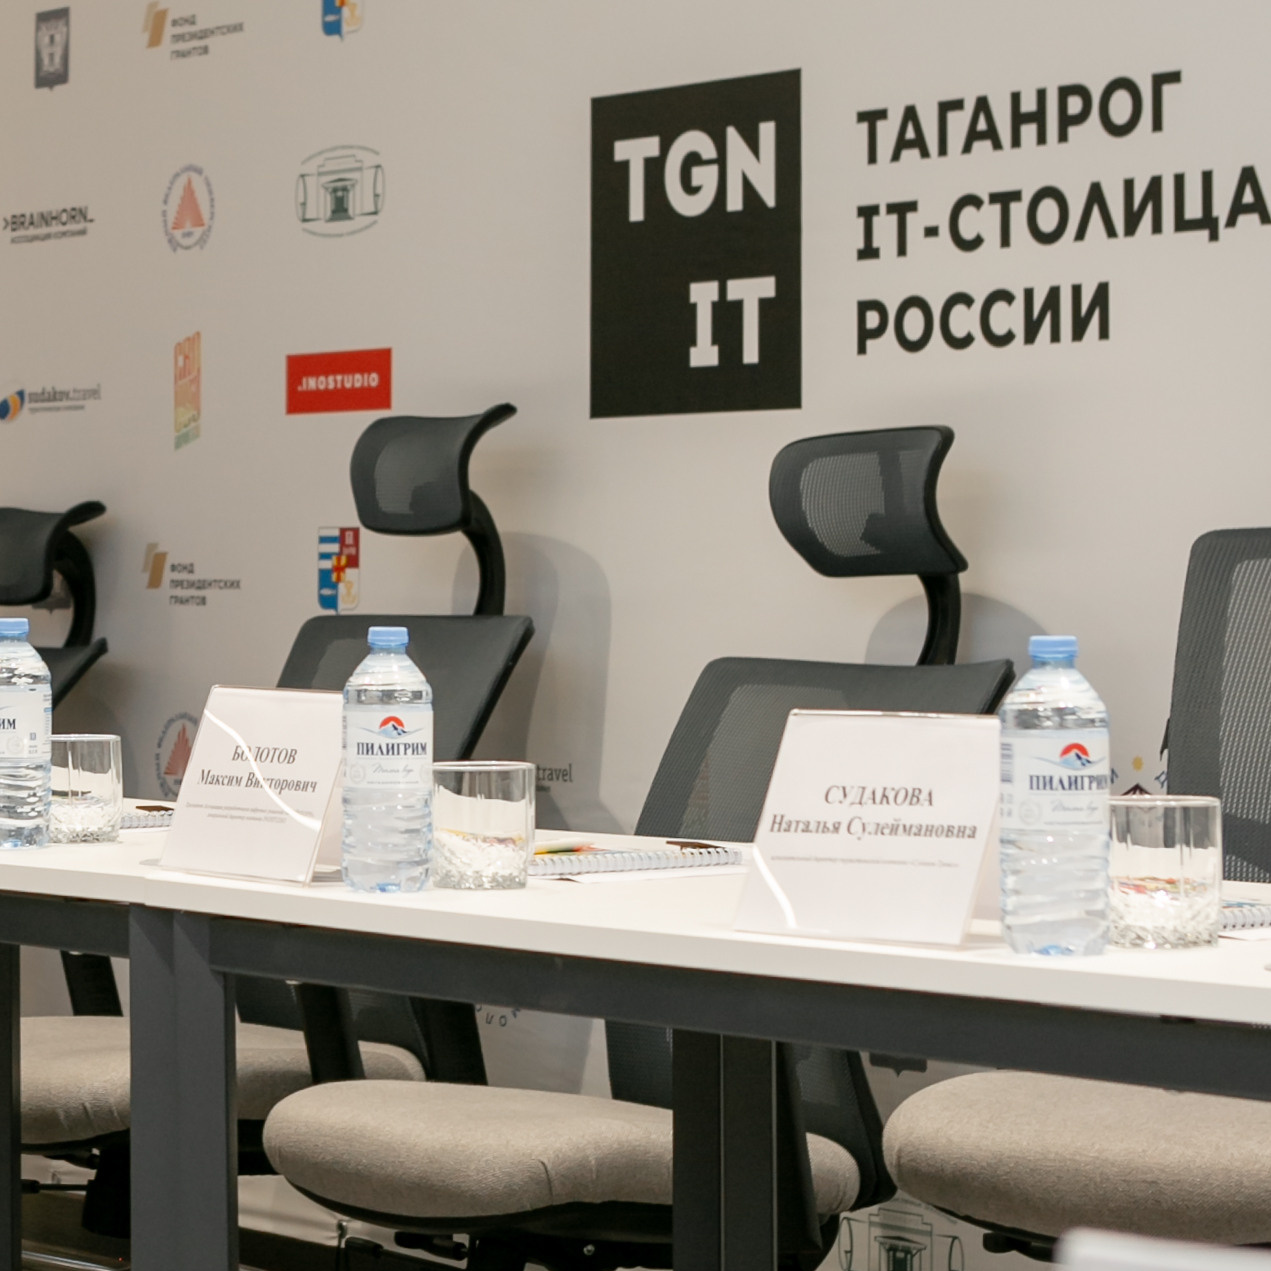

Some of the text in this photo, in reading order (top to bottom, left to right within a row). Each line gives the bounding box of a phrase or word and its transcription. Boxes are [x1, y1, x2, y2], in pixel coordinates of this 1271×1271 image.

[857, 70, 1182, 165] ТАГАНРОГ
[614, 121, 776, 222] TGN
[857, 165, 1271, 261] IT-СТОЛИЦА
[689, 276, 776, 367] IT
[857, 281, 1110, 355] РОССИИ
[198, 769, 243, 788] Максим
[357, 742, 427, 756] ПИЛИГРИМ
[770, 814, 978, 841] Наталья Сулеймановна
[824, 785, 934, 807] СУДАКОВА
